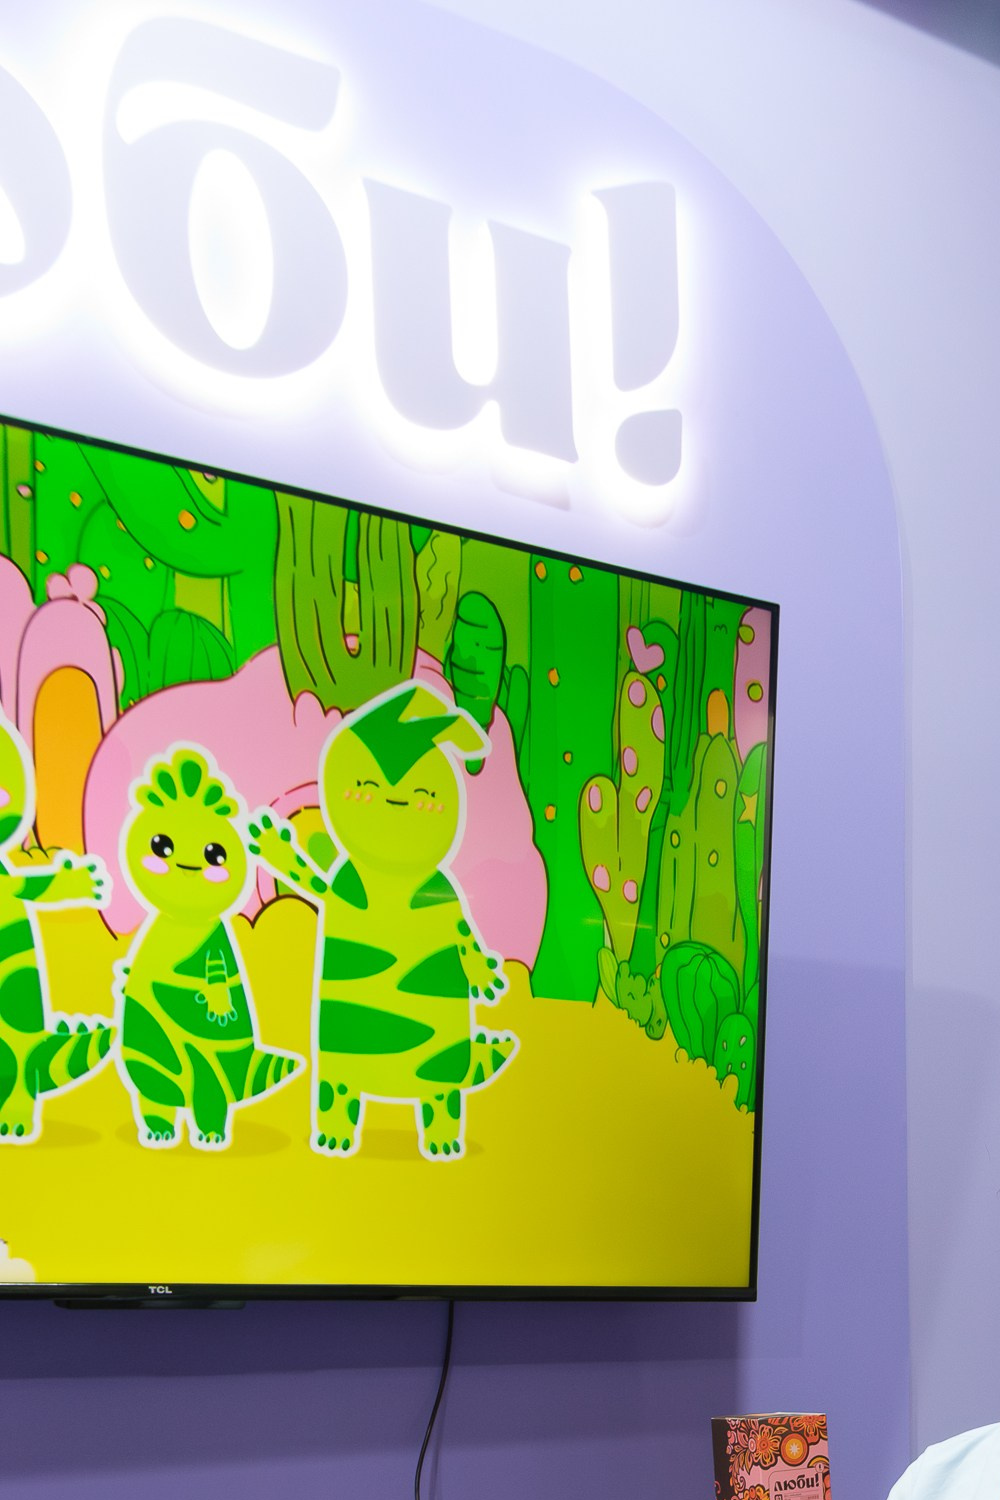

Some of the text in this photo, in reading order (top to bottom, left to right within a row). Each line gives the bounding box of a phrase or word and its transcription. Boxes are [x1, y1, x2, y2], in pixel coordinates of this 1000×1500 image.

[0, 16, 682, 486] би!
[149, 1285, 172, 1294] TCL
[774, 1472, 820, 1492] люби!
